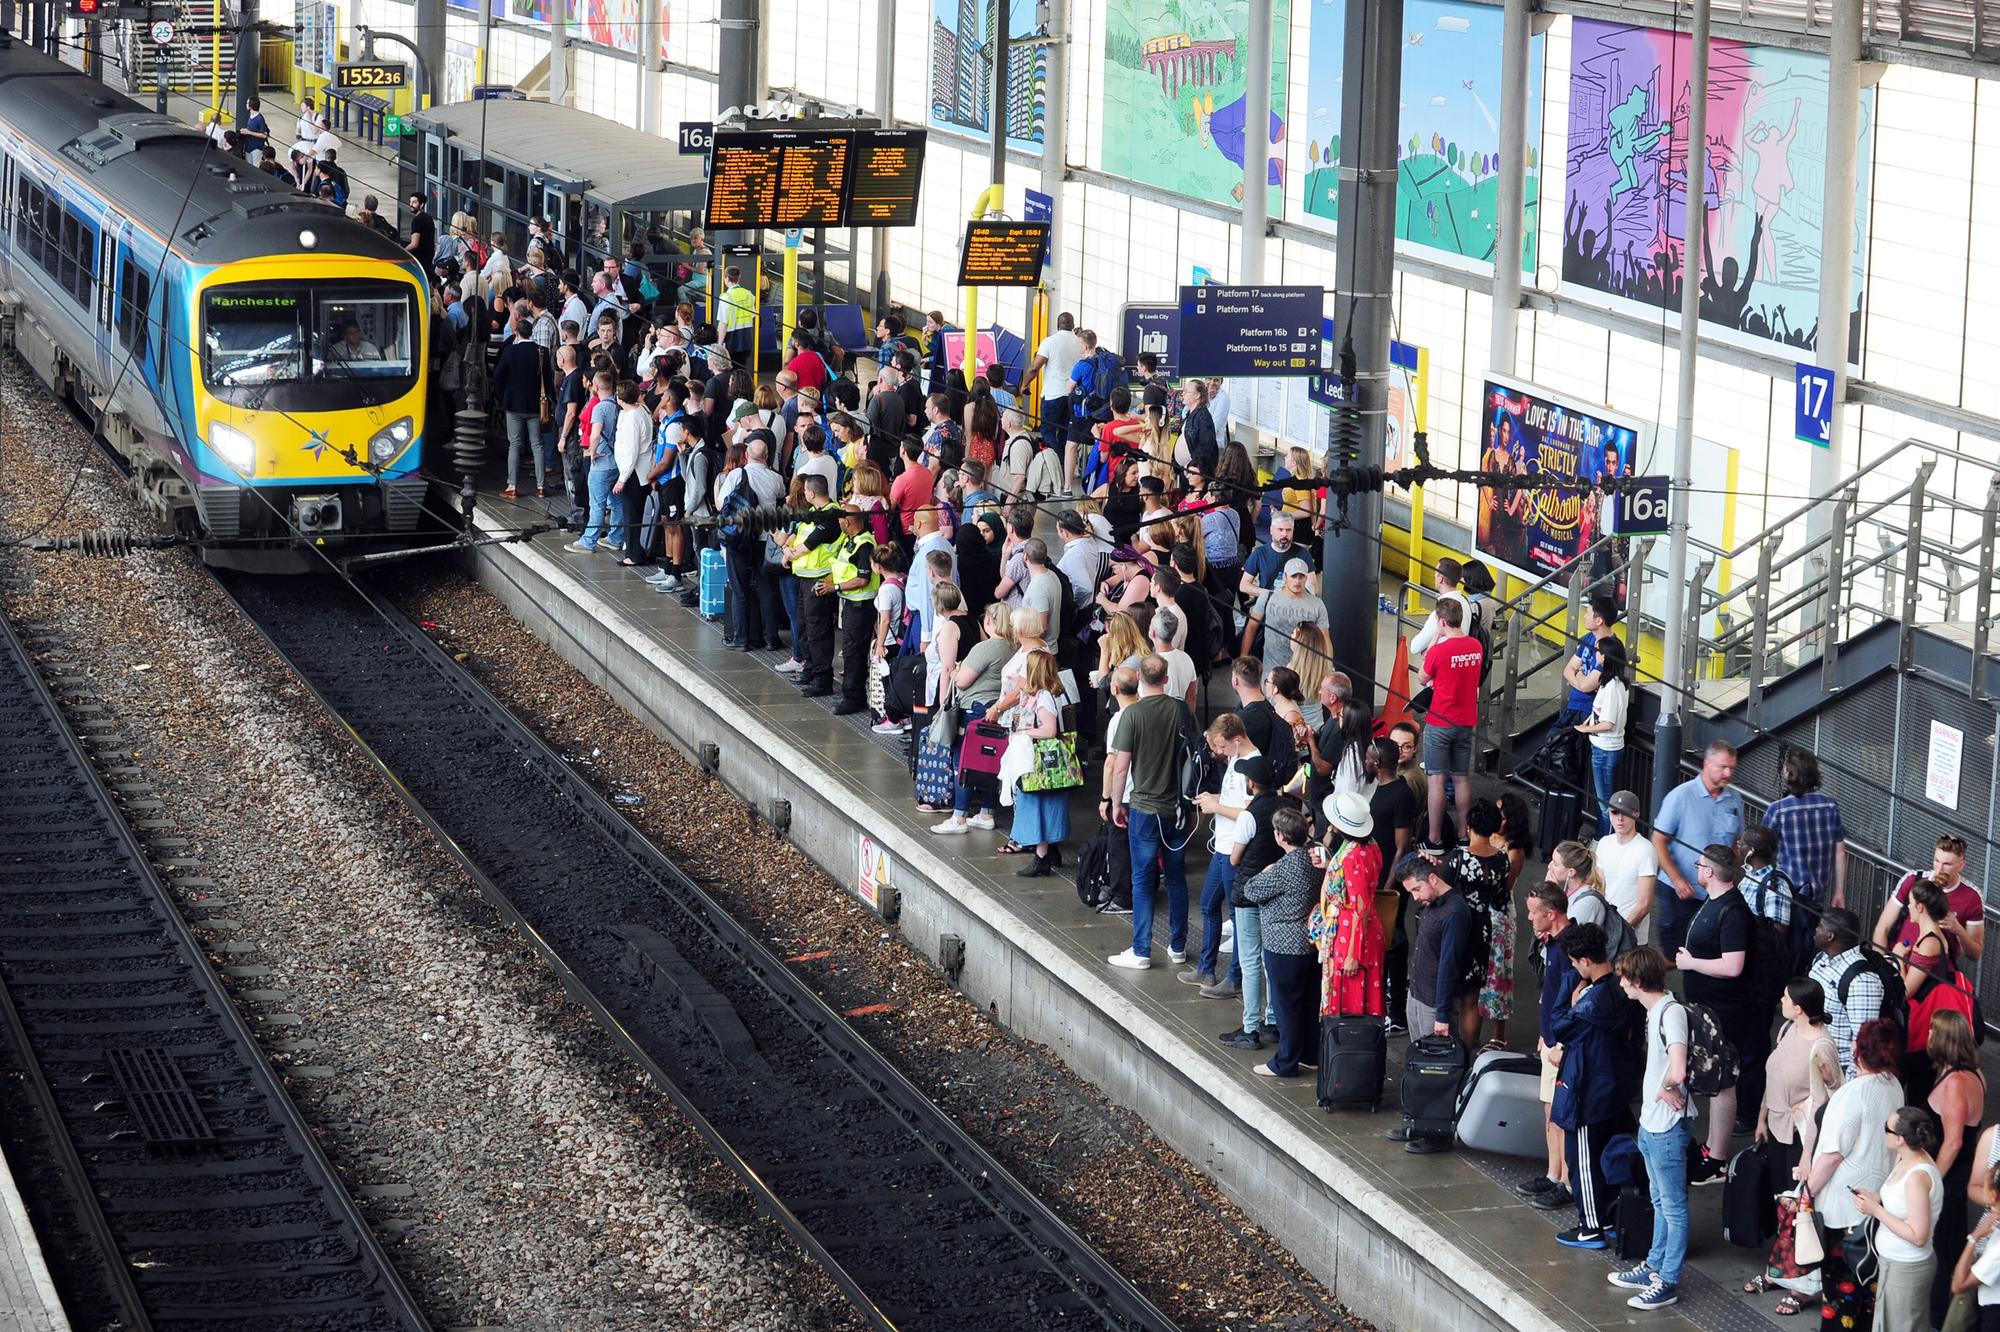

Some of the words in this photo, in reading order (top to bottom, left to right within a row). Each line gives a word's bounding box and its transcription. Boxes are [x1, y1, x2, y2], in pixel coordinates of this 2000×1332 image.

[156, 26, 170, 38] 25
[681, 128, 712, 148] 16a
[212, 297, 296, 306] Manchester
[1217, 290, 1249, 298] Platform
[1254, 359, 1271, 368] Way
[1325, 378, 1344, 400] Leed
[1802, 374, 1828, 418] 17
[1525, 405, 1548, 430] LOVE
[1547, 410, 1557, 432] IS
[1557, 415, 1568, 436] IN
[1569, 417, 1584, 442] THE
[1585, 424, 1600, 448] AIR
[1538, 443, 1577, 477] STRICTLY
[1622, 488, 1667, 521] 16a
[1551, 528, 1574, 541] MUSICAL
[1451, 653, 1481, 663] macron
